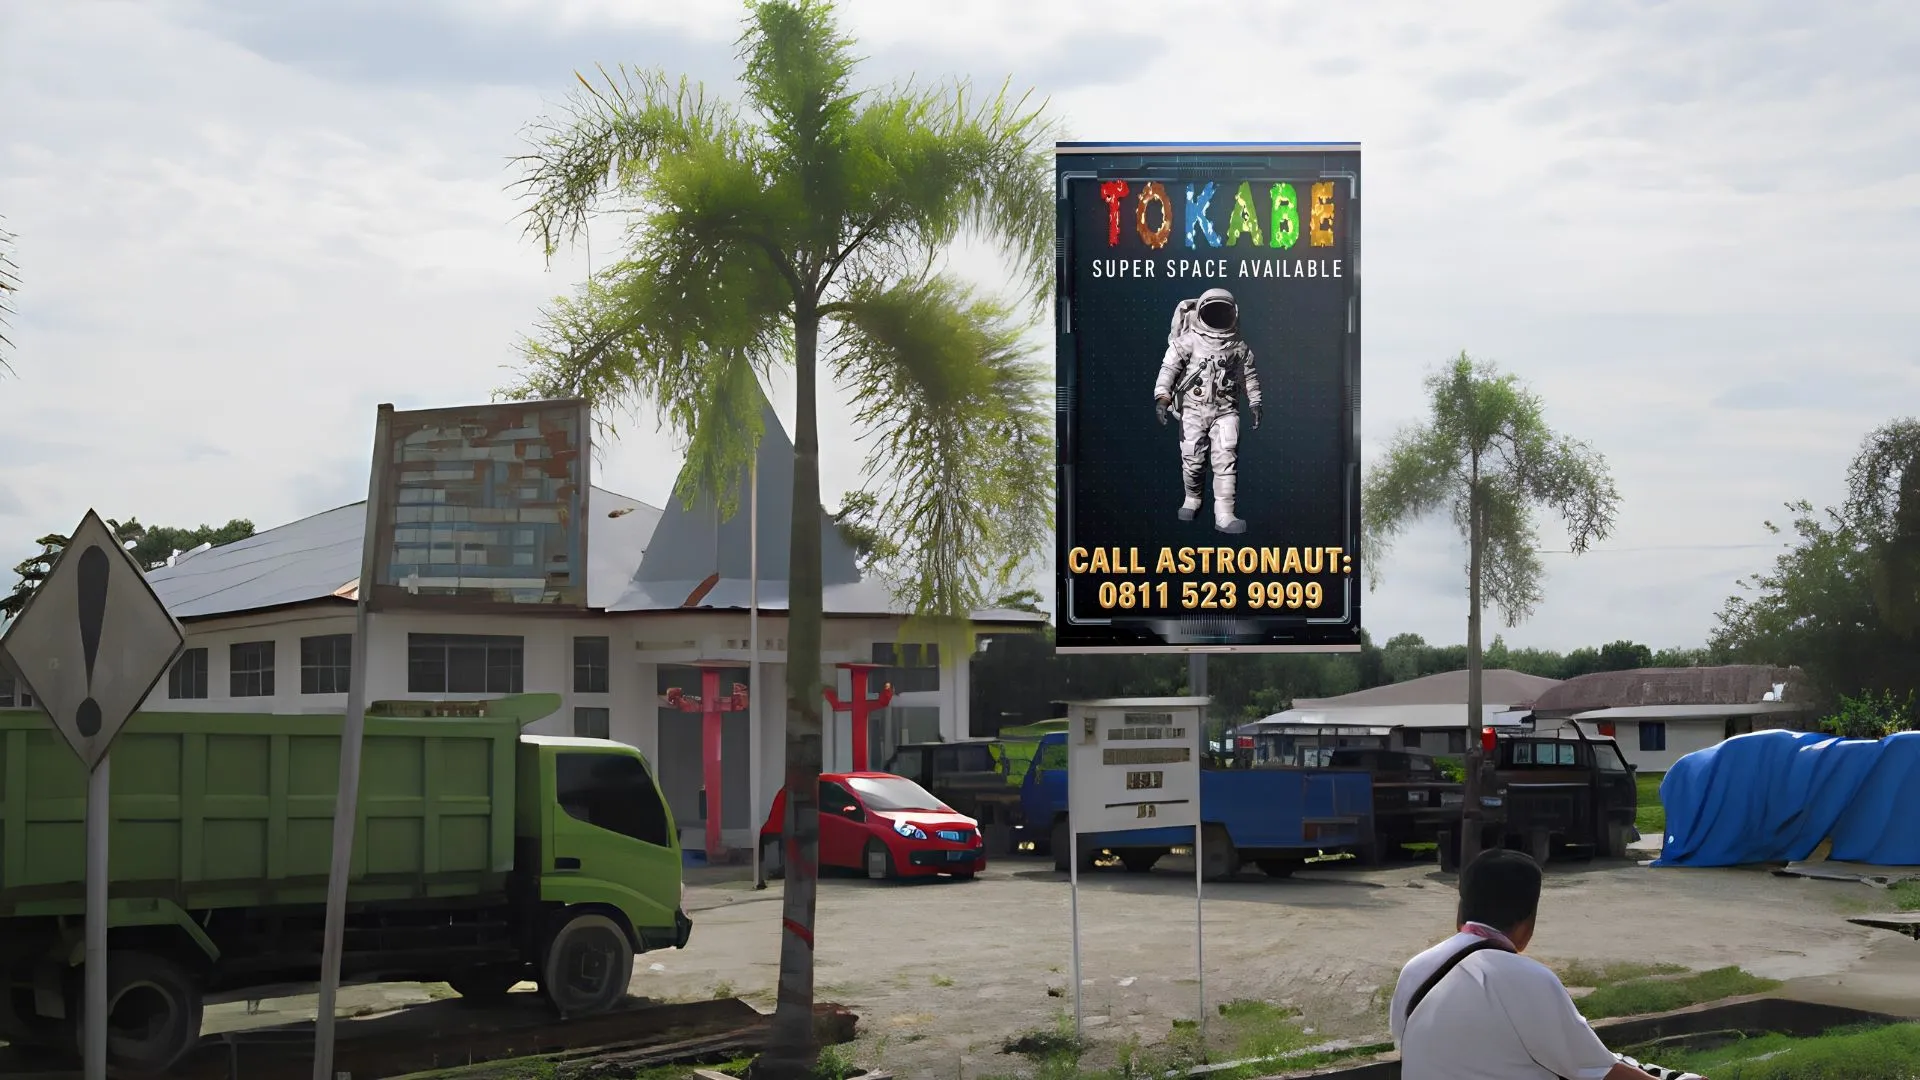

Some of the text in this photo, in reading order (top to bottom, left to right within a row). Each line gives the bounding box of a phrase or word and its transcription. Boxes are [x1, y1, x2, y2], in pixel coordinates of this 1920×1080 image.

[1100, 179, 1335, 249] TOKABE
[1092, 259, 1342, 278] SUPER SPACE AVAILABLE
[1068, 547, 1352, 574] CALL ASTRONAUT:
[1098, 581, 1323, 609] 0811 523 9999
